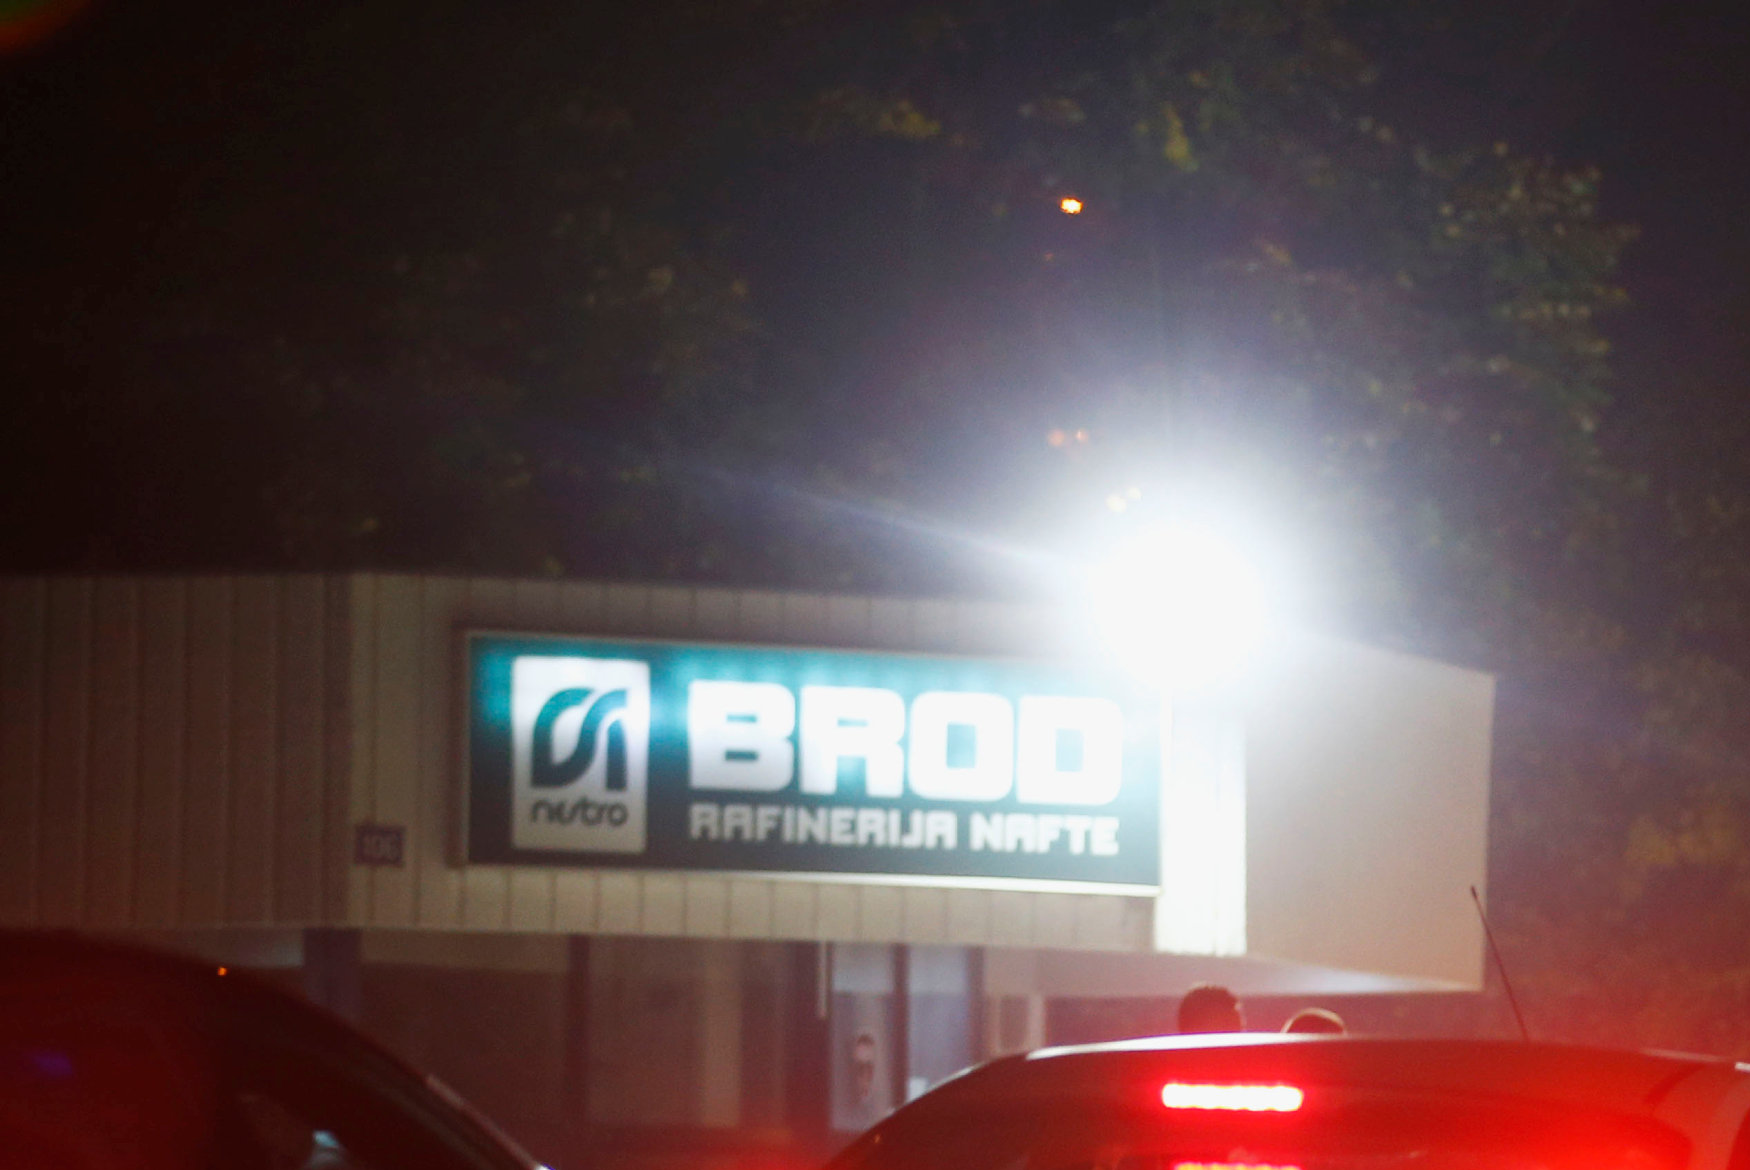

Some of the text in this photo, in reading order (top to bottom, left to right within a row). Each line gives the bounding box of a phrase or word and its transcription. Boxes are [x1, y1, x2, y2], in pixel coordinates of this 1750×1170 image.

[688, 679, 1123, 807] BROD
[689, 802, 1120, 856] RAFINERIJA NAFTE
